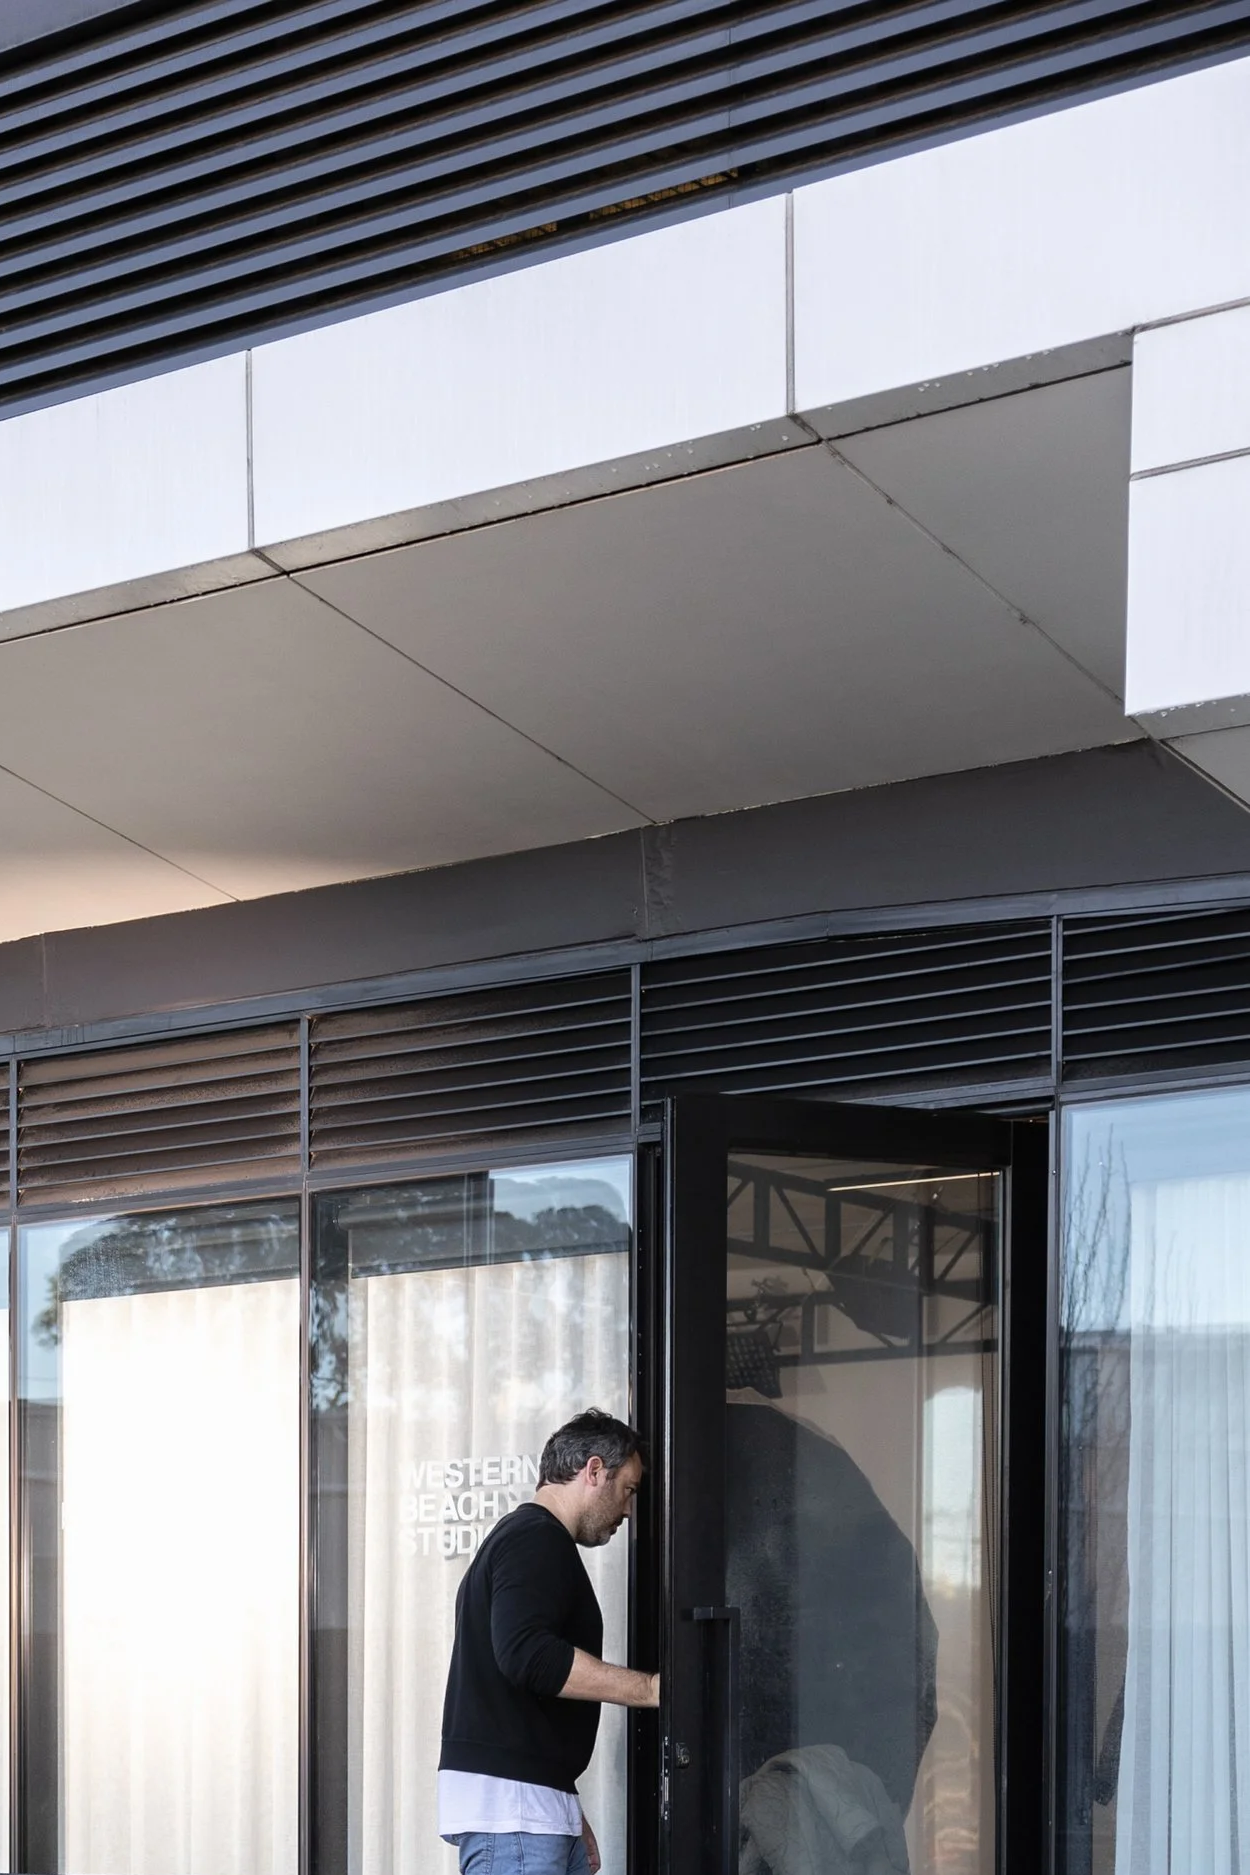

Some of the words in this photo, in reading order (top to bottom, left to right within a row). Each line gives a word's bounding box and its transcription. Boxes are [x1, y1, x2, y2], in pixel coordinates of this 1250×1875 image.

[398, 1454, 540, 1489] WESTERN
[400, 1490, 499, 1522] BEACH
[399, 1524, 495, 1557] STUDI
